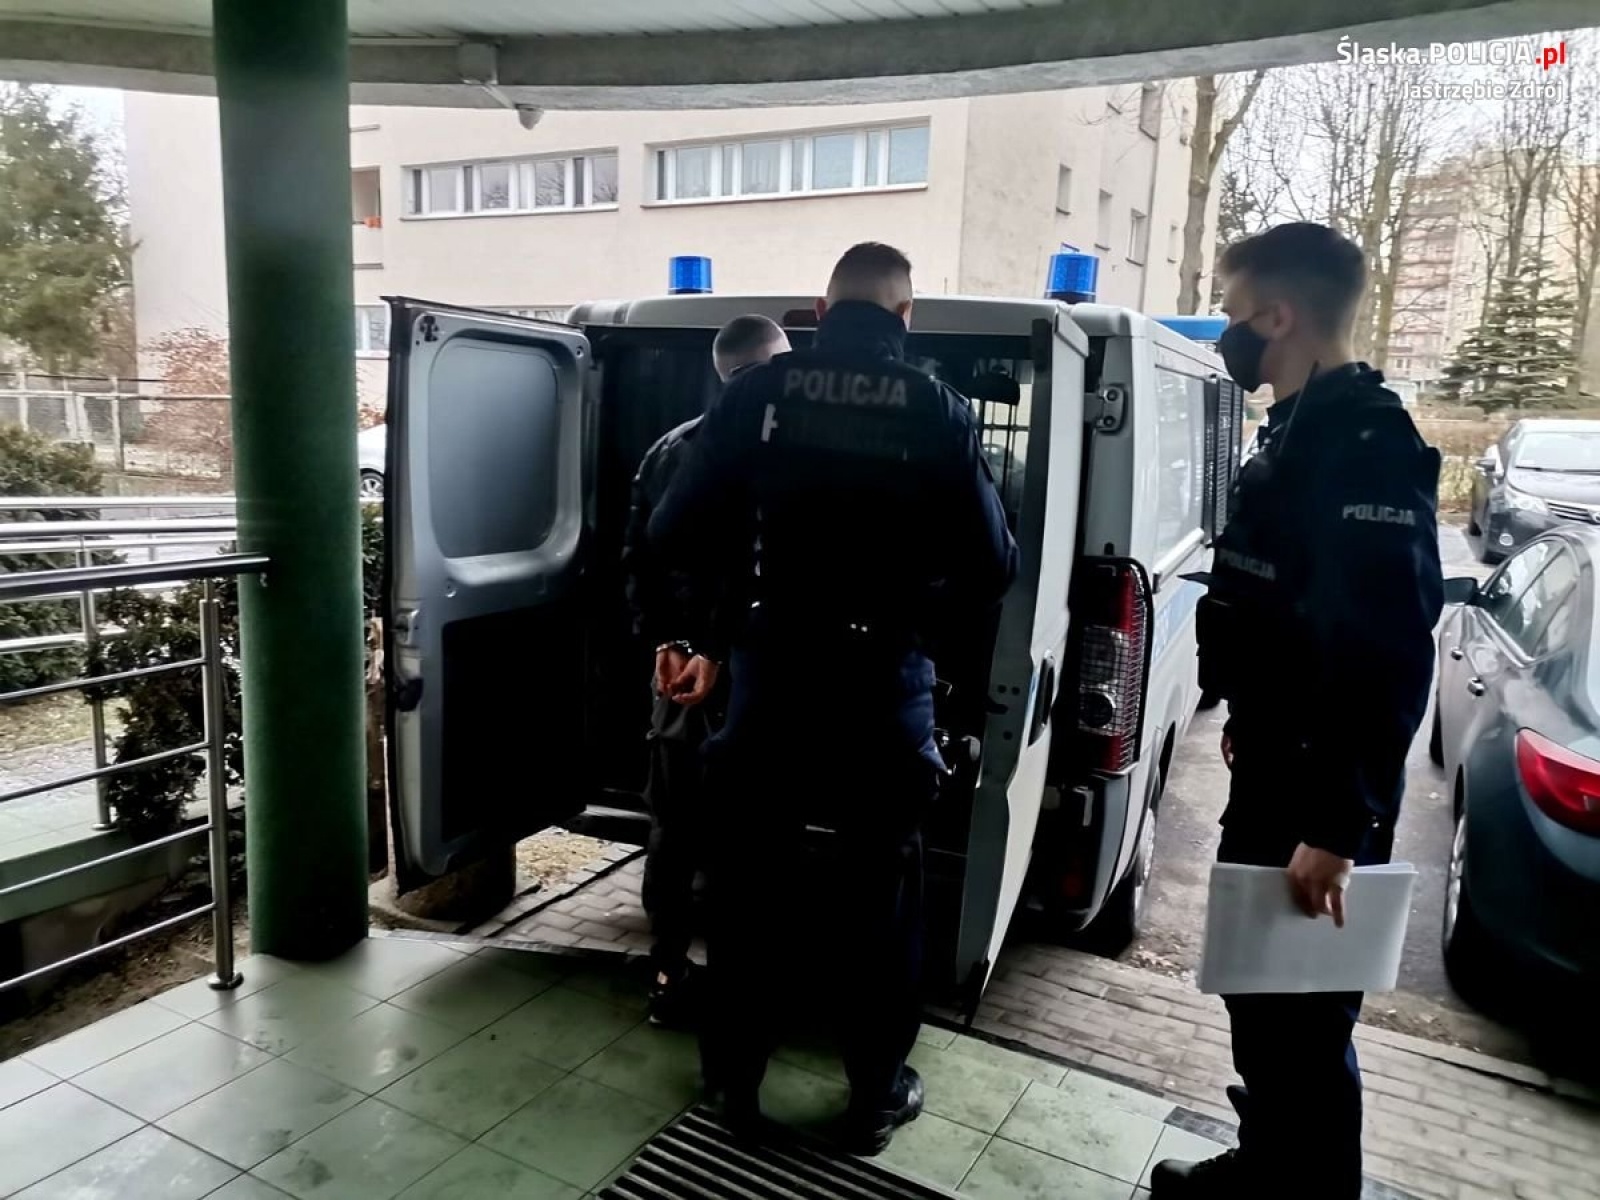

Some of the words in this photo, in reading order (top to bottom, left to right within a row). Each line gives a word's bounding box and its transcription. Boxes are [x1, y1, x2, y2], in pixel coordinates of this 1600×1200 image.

[783, 367, 908, 408] POLICJA
[1342, 503, 1416, 527] POLICJA
[1218, 549, 1277, 581] POLICJA
